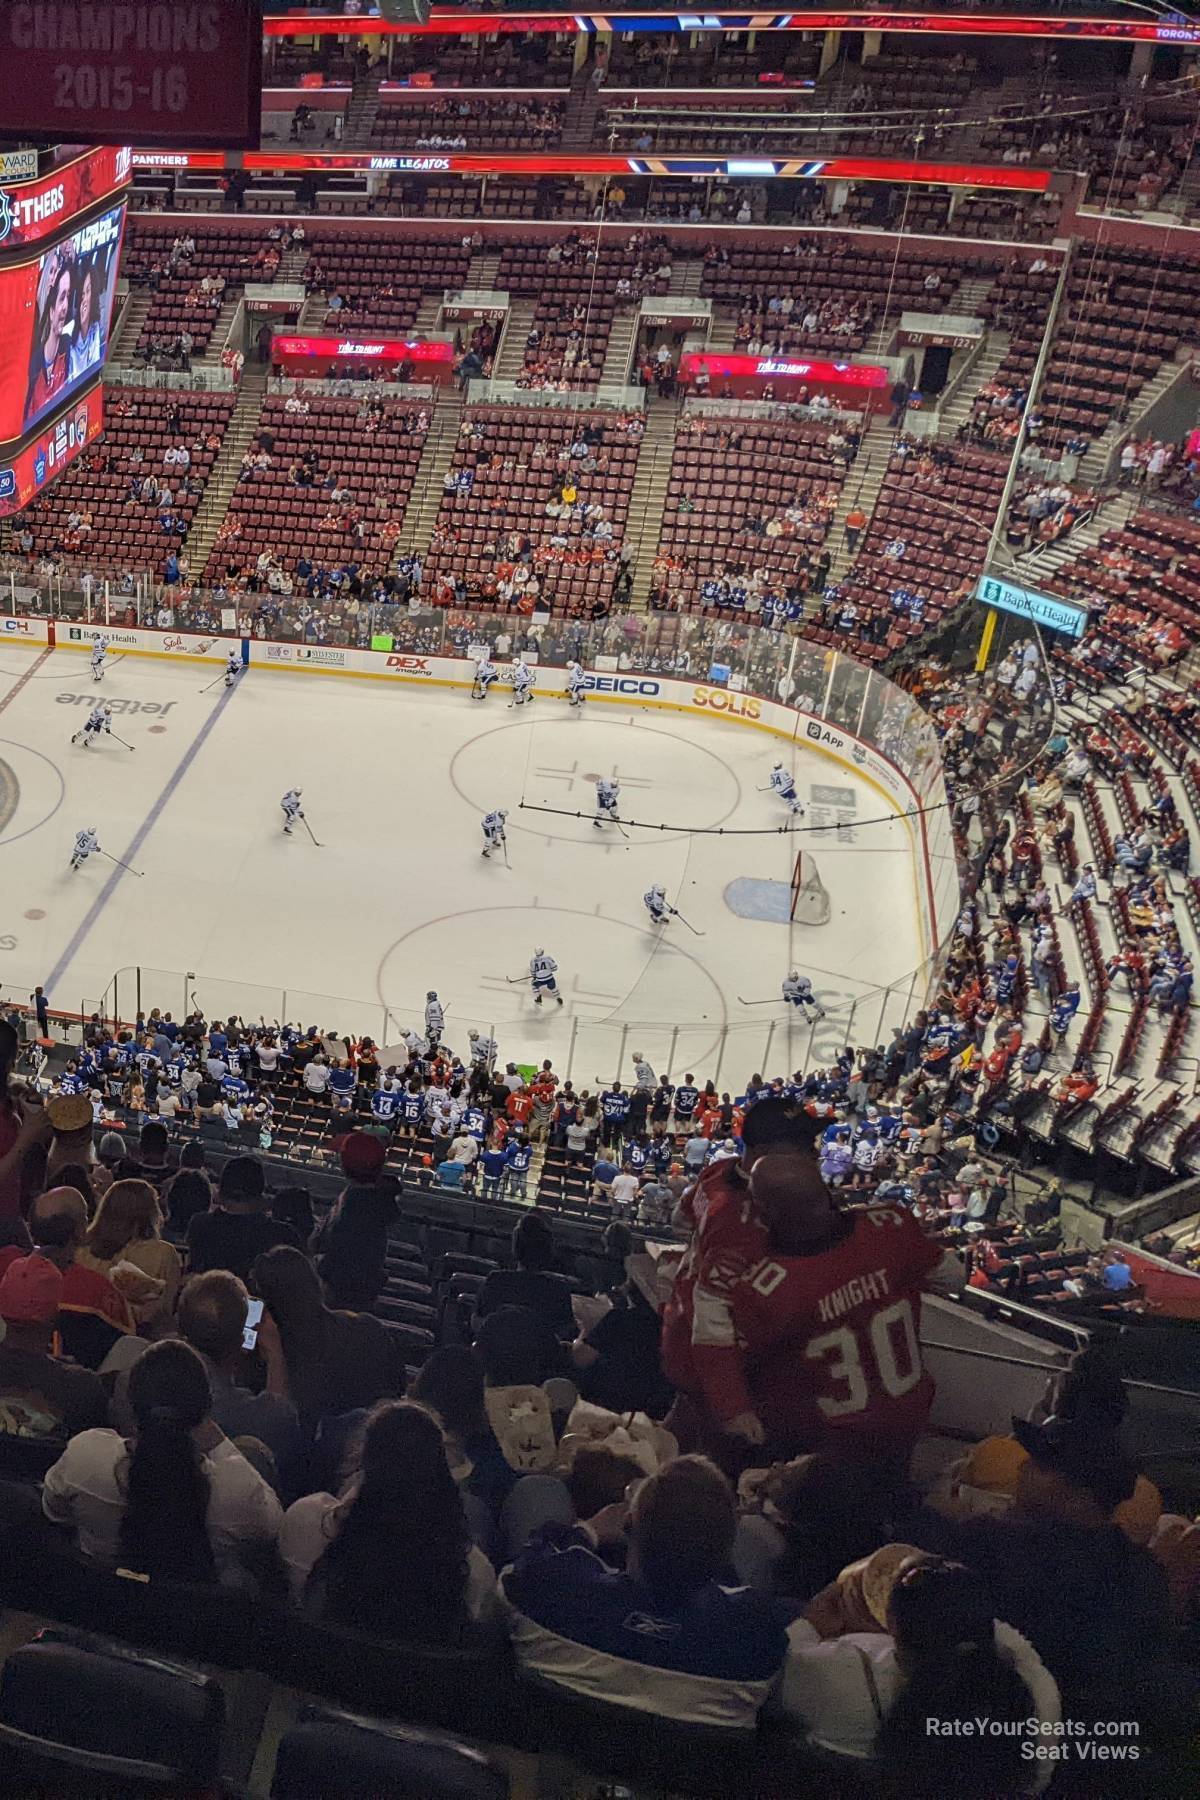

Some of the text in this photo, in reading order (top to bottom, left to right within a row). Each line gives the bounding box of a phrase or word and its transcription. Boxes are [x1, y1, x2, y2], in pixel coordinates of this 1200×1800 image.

[11, 3, 220, 50] CHAMPIONS
[53, 63, 189, 112] 2015-16
[132, 155, 189, 165] PANTHERS
[0, 477, 10, 488] 50
[1003, 591, 1079, 625] Baptist Health
[6, 620, 28, 631] CH
[112, 632, 138, 644] Health
[386, 655, 431, 669] DEX
[395, 667, 432, 676] imaging
[692, 687, 763, 720] SOLIS
[76, 836, 89, 848] 15
[534, 961, 547, 972] 44
[168, 1067, 179, 1080] 34
[379, 1100, 391, 1113] 14
[514, 1101, 523, 1112] 11
[680, 1095, 694, 1107] 34
[406, 1105, 418, 1118] 16
[468, 1117, 484, 1133] 34
[906, 1142, 919, 1154] 16
[818, 1268, 890, 1323] KNIGHT
[805, 1300, 922, 1418] 30
